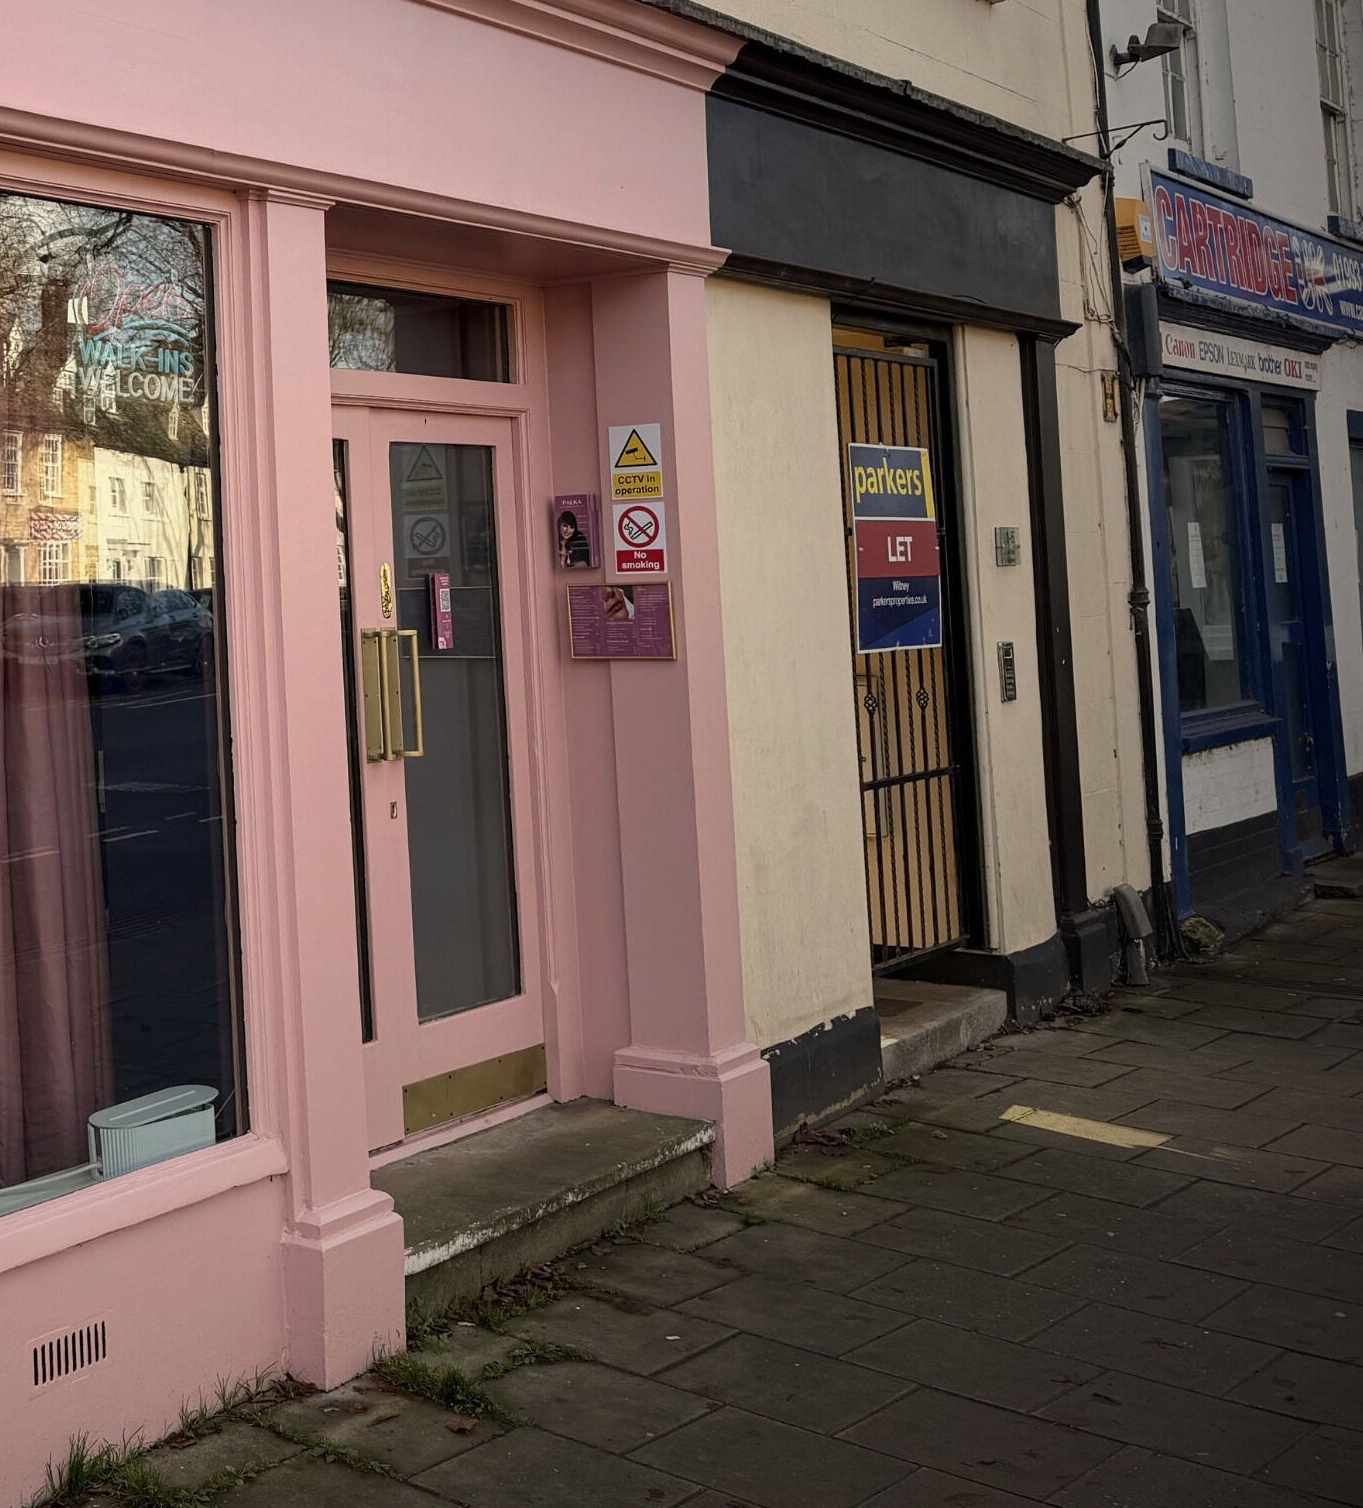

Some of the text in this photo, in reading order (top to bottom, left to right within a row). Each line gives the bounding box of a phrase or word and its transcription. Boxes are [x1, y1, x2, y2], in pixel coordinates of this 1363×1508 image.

[1155, 185, 1298, 305] CARTRIDGE
[1332, 253, 1363, 292] 01993
[79, 340, 194, 376] WALK-INS
[1165, 334, 1302, 379] Canon EPSON LEXMARK brother OKI
[79, 367, 195, 402] WELCOME
[615, 485, 659, 496] operation
[617, 475, 656, 484] CCTV in
[853, 457, 922, 504] parkers
[633, 550, 647, 559] No
[887, 536, 913, 562] LET
[621, 559, 660, 570] smoking
[892, 580, 910, 592] Witney
